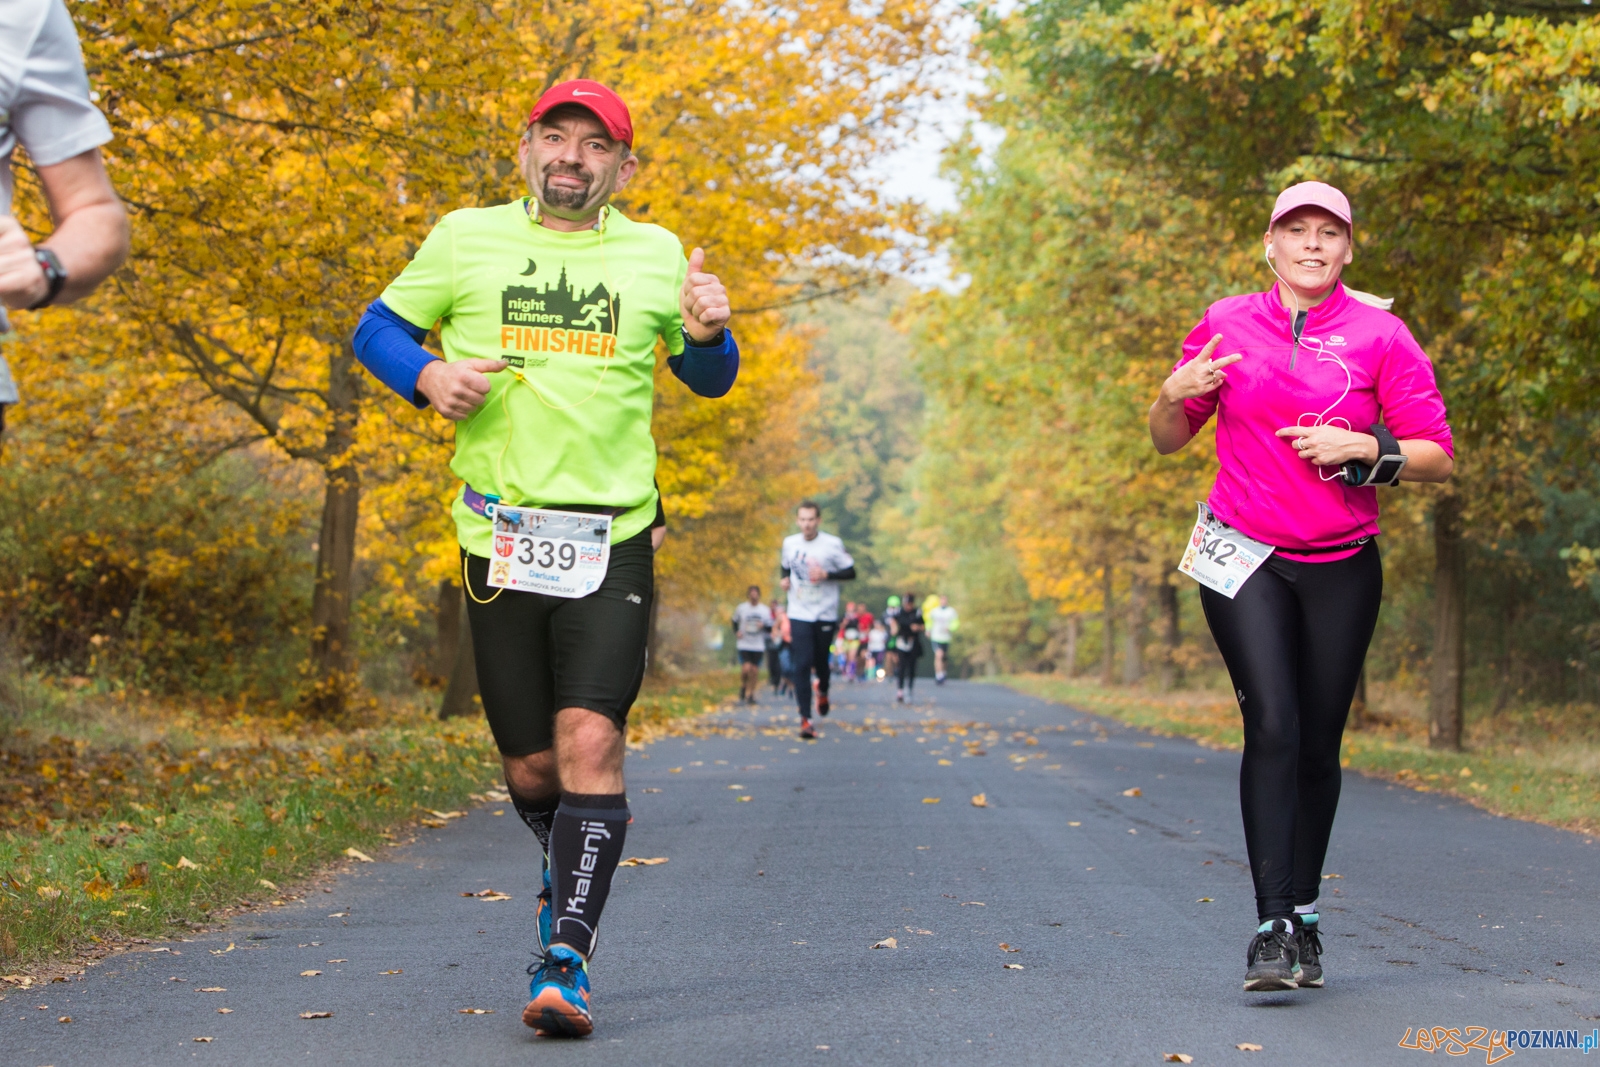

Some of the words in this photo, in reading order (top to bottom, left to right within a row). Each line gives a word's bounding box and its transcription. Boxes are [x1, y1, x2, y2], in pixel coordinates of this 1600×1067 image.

[508, 298, 546, 312] night
[508, 311, 564, 324] runners
[501, 327, 616, 358] FINISHER
[518, 537, 576, 571] 339
[1199, 530, 1237, 567] 542
